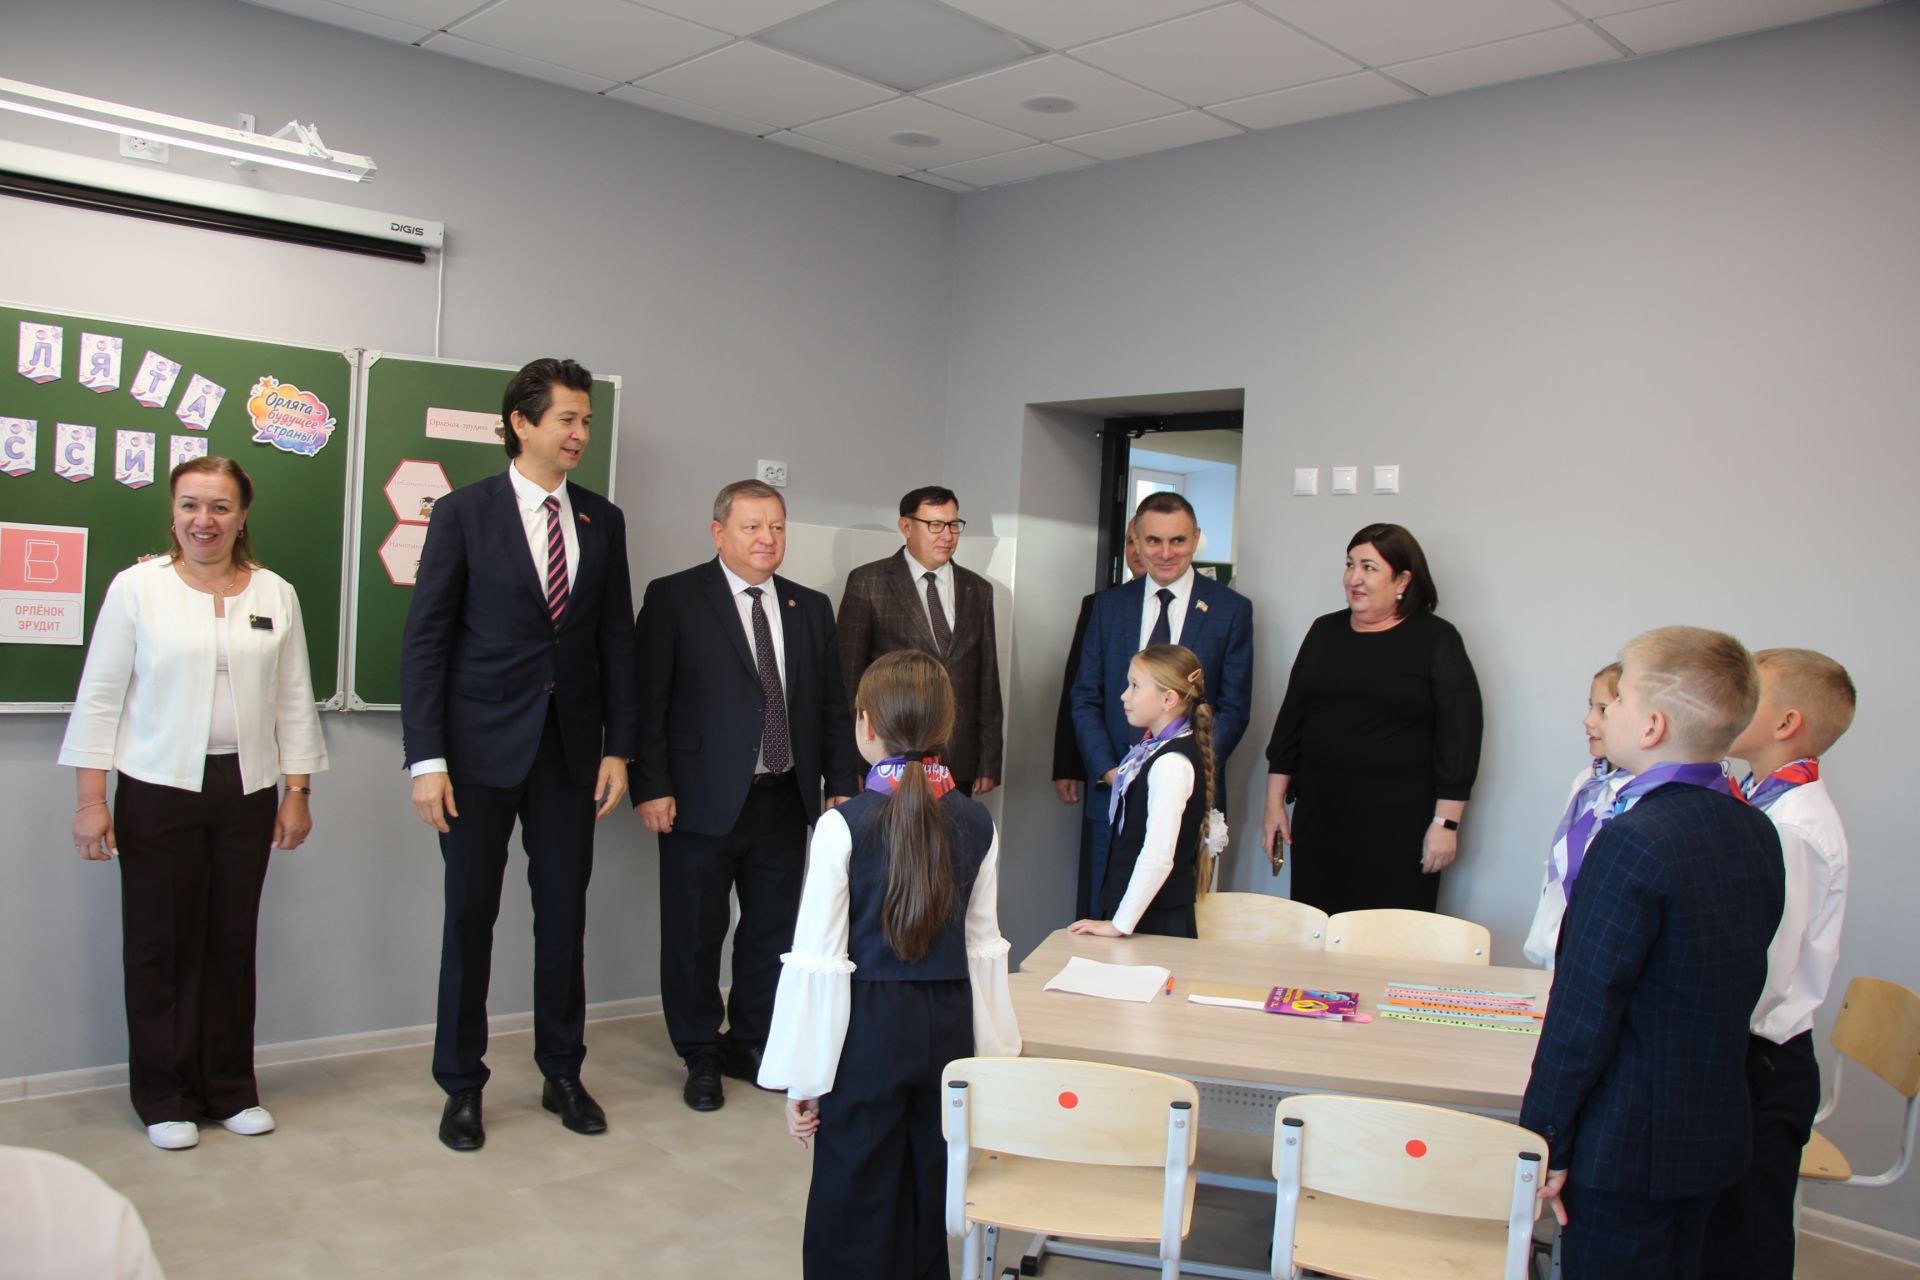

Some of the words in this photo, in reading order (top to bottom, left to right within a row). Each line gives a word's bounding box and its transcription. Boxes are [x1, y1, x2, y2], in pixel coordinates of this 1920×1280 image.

[391, 222, 424, 236] DIGIS
[265, 391, 314, 416] Орлята
[267, 408, 319, 430] будущее
[266, 424, 318, 445] страны!
[15, 604, 65, 617] ОРЛЁНОК
[18, 620, 61, 632] ЭРУДИТ
